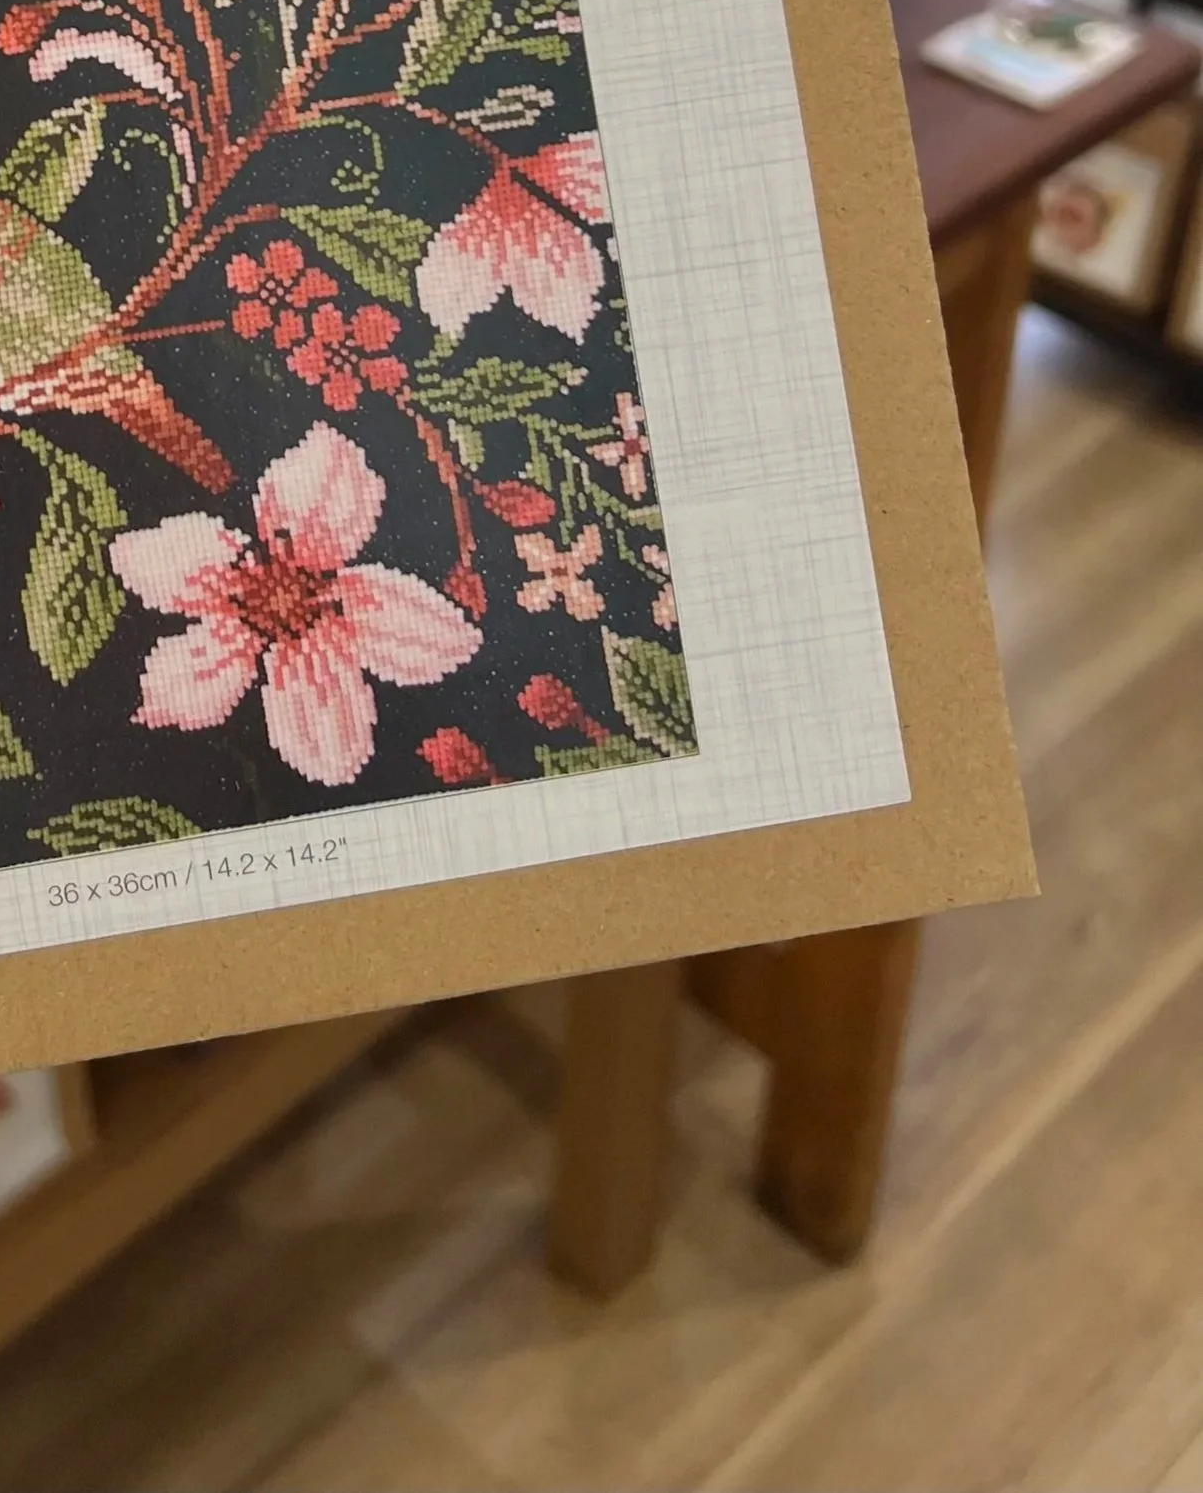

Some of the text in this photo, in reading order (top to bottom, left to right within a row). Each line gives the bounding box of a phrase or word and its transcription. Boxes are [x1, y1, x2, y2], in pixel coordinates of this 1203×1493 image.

[48, 836, 347, 907] 36 x 36cm / 14.2 x 14.2"
